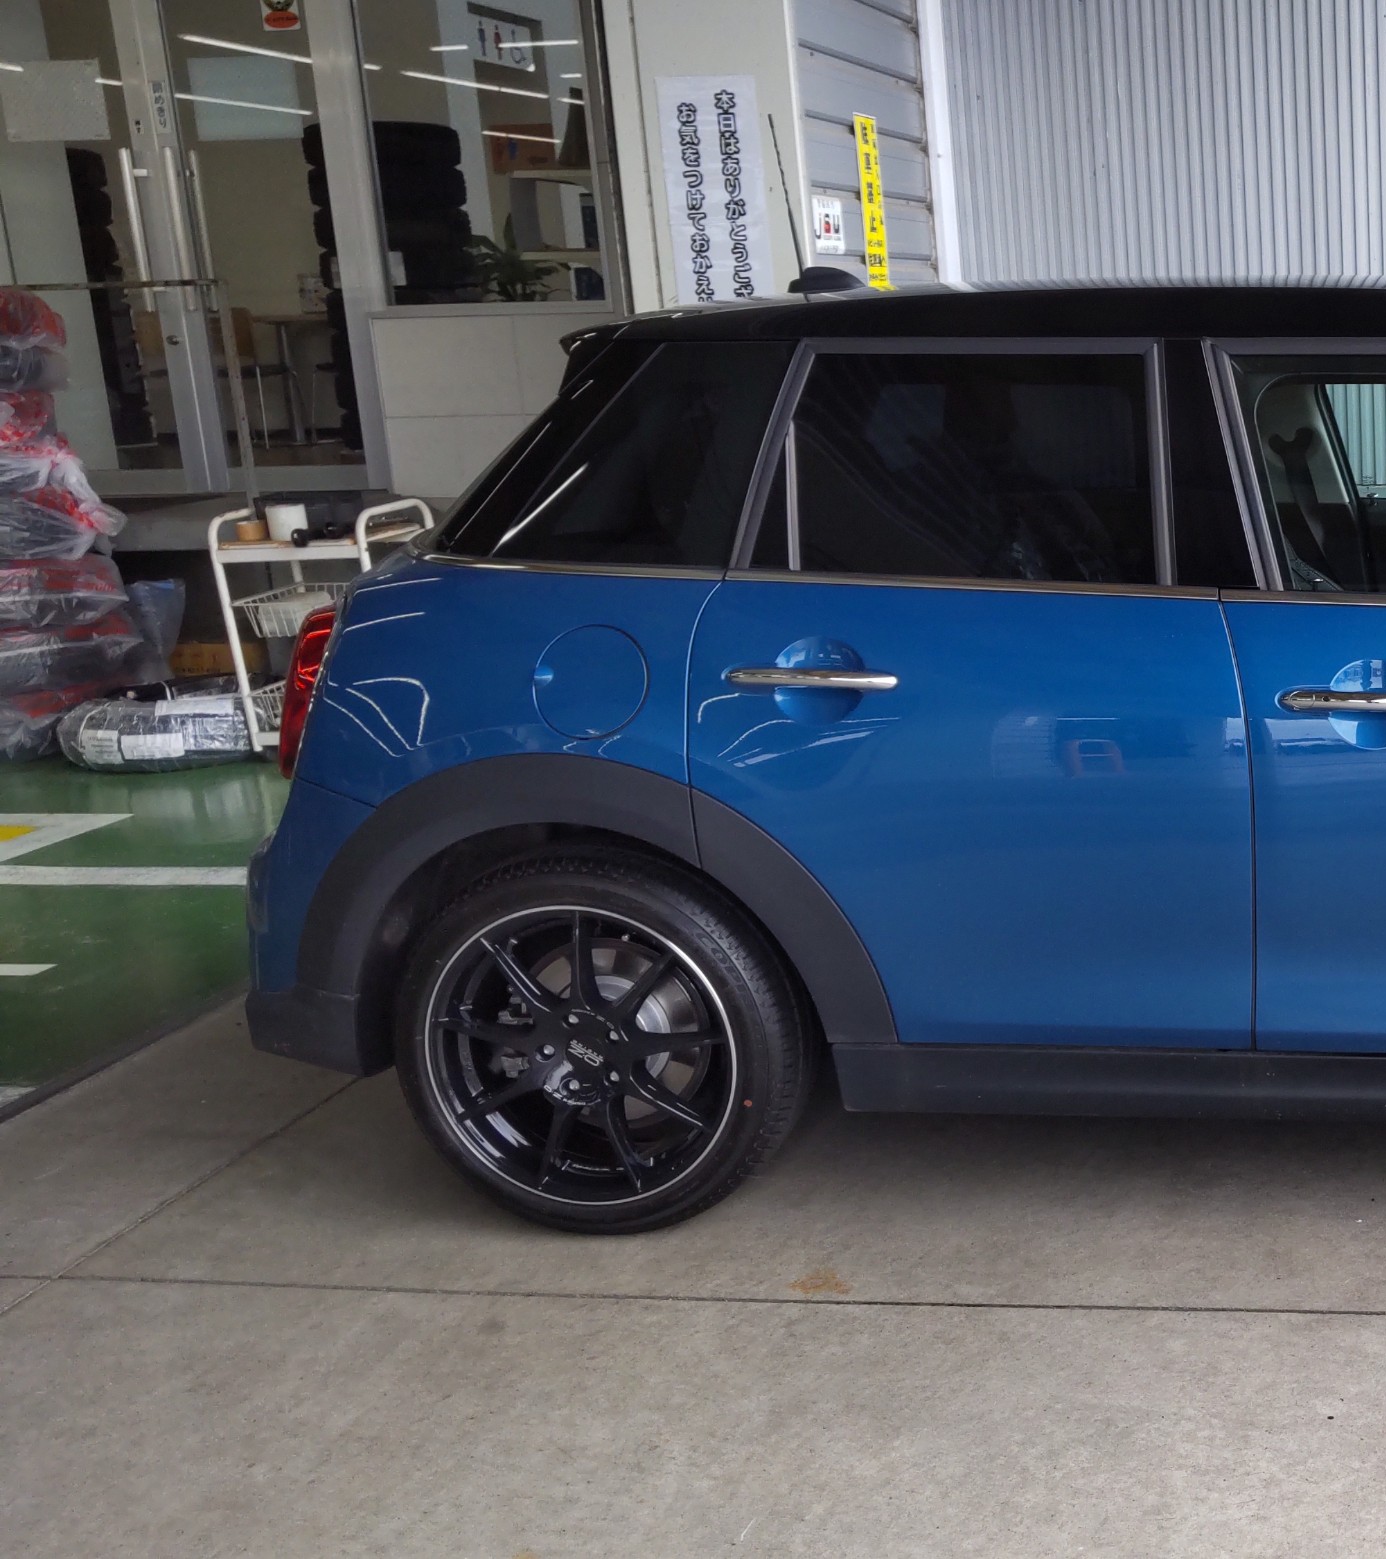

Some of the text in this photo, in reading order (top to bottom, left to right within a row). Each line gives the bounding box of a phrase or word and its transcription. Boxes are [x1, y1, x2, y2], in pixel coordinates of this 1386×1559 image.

[676, 102, 715, 302] お気をつけておかえ
